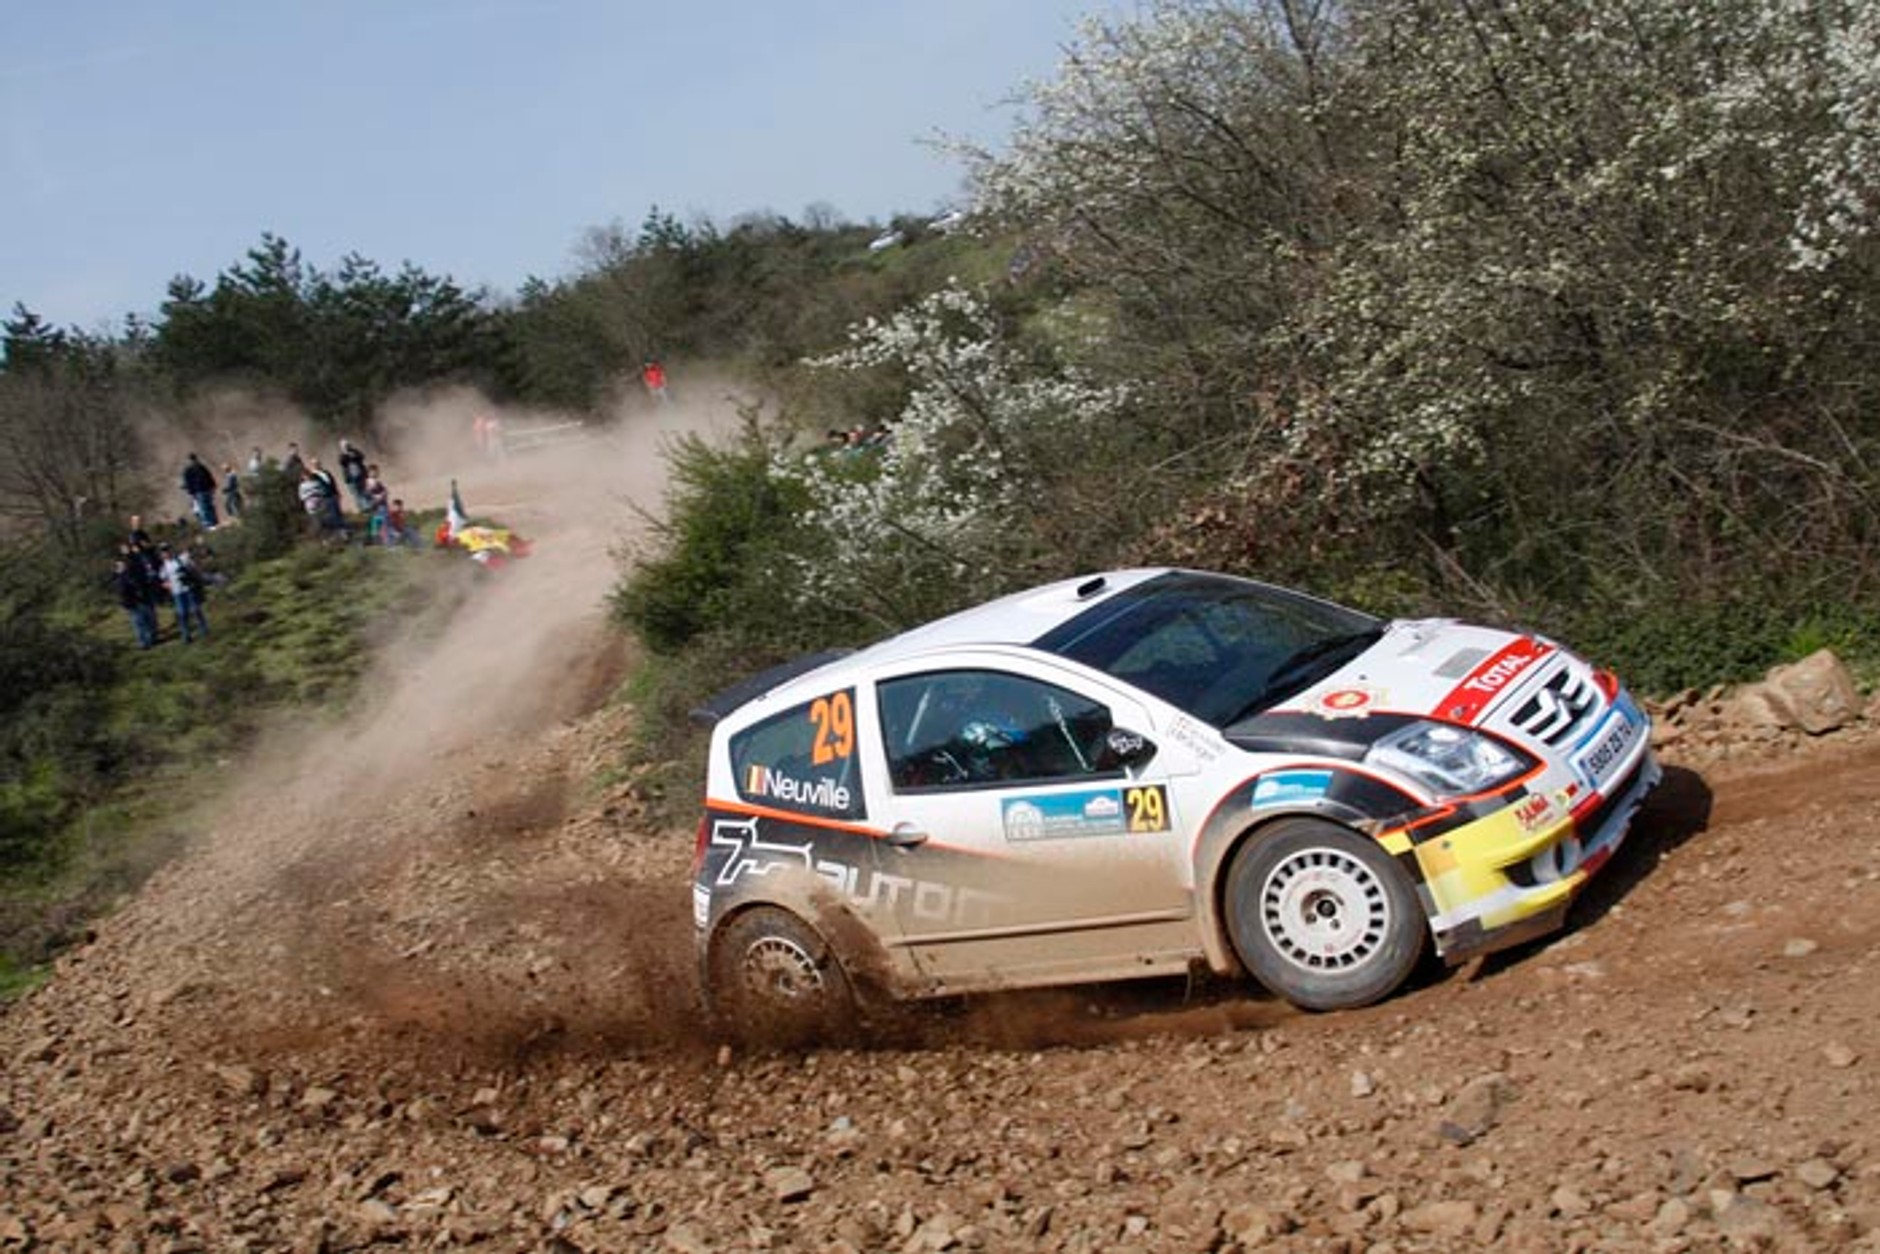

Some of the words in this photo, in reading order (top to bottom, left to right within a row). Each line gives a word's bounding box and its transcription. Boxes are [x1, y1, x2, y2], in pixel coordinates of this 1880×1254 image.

[1463, 654, 1531, 693] TOTAL
[810, 692, 854, 765] 29
[762, 768, 850, 809] Neuville
[1127, 786, 1163, 833] 29
